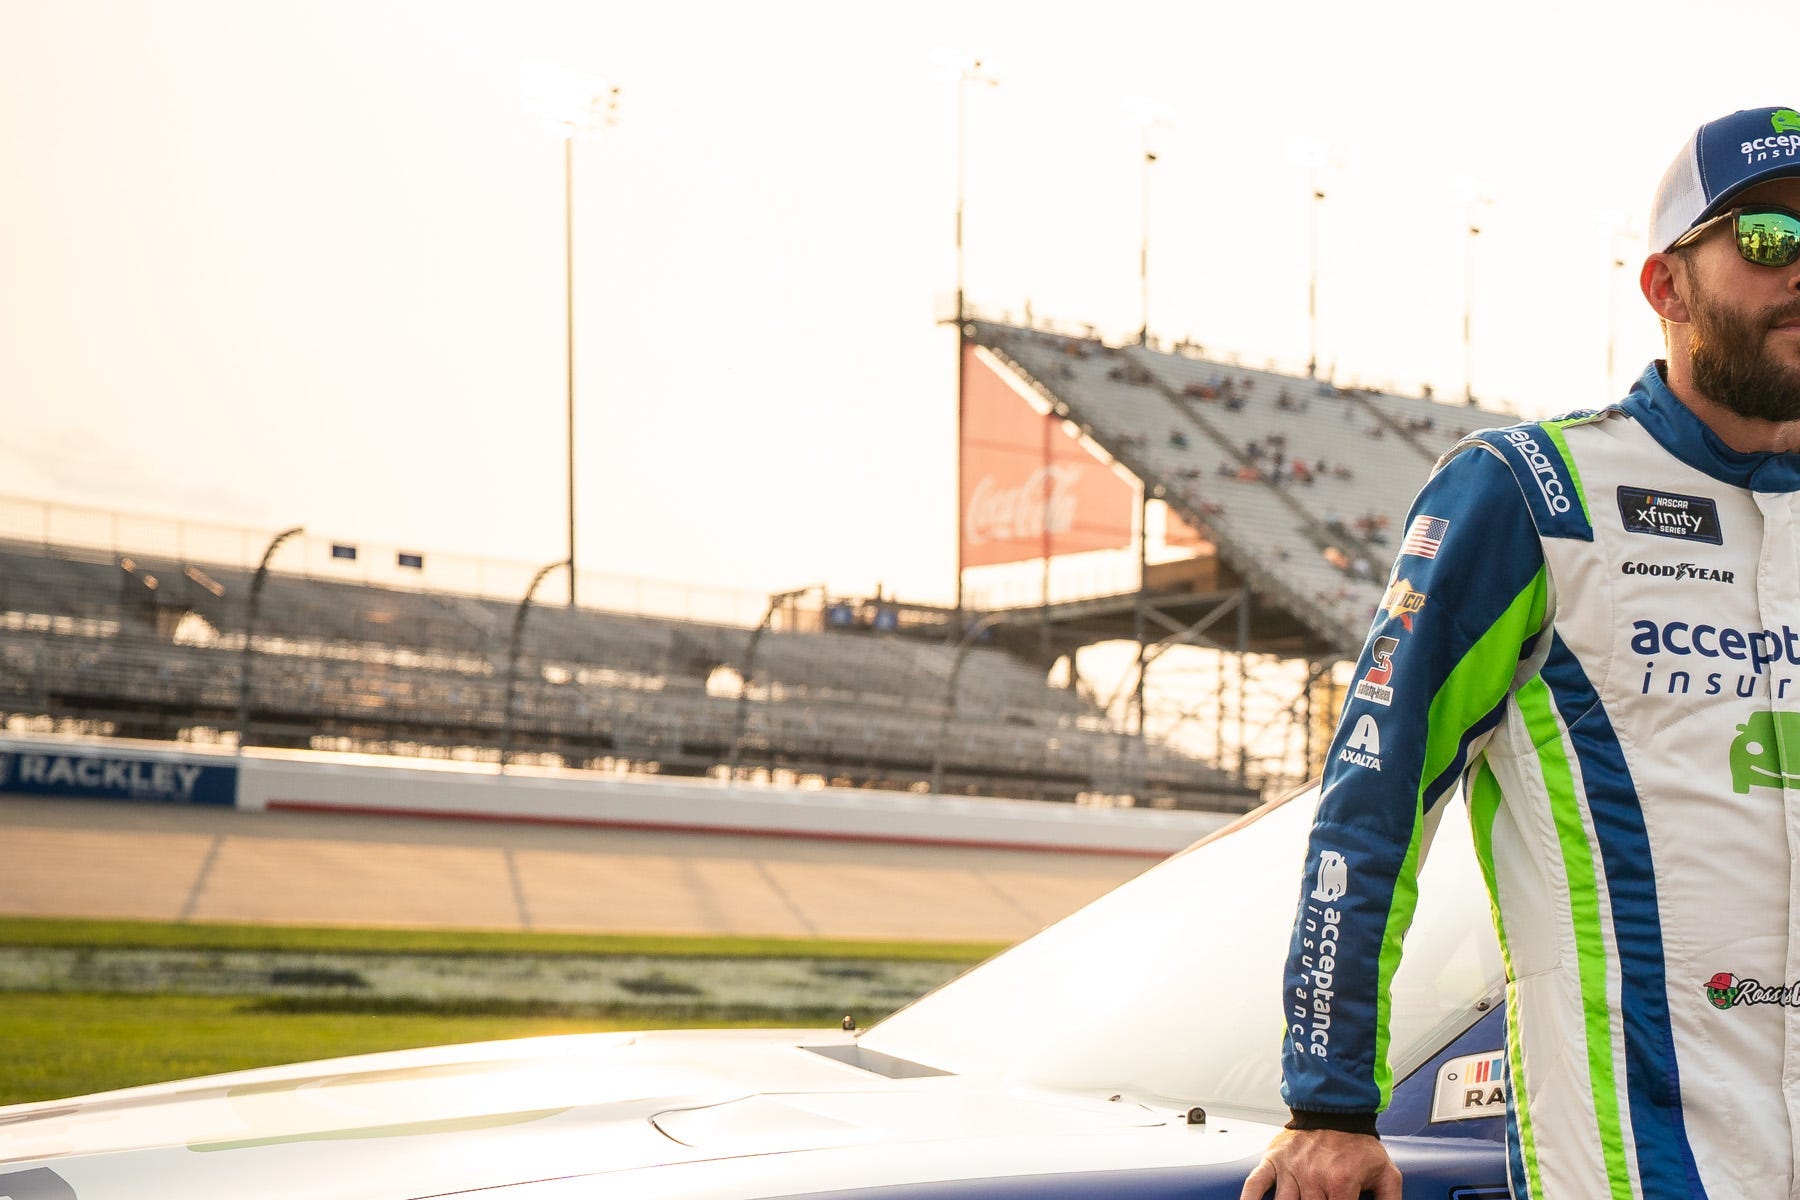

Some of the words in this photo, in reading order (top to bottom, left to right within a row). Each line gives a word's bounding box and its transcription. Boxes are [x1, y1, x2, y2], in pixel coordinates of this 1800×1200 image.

[1503, 431, 1571, 517] sparco
[1637, 506, 1703, 533] xfinity
[1656, 497, 1689, 509] NASCAR
[1660, 525, 1687, 535] SERIES
[19, 754, 201, 795] RACKLEY
[1338, 748, 1383, 772] AXALTA
[1291, 904, 1323, 1054] insurance
[1310, 905, 1342, 1058] acceptance
